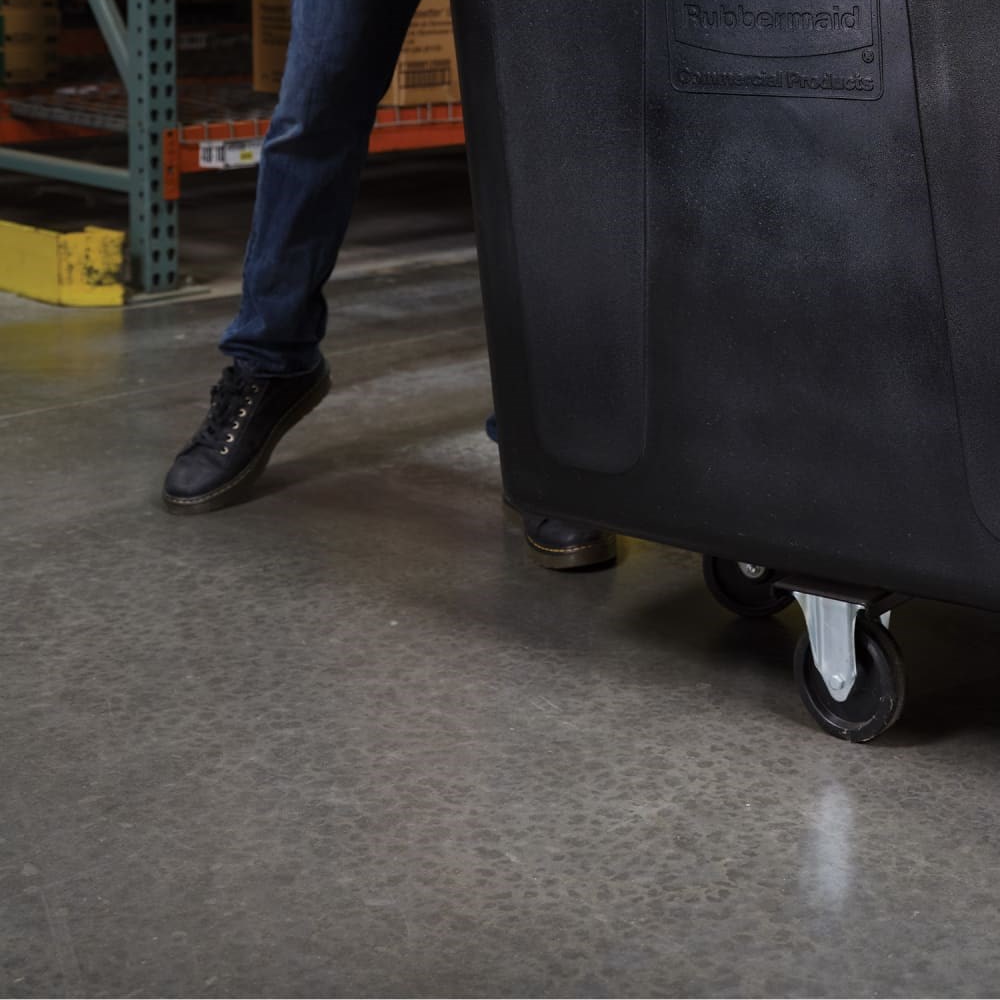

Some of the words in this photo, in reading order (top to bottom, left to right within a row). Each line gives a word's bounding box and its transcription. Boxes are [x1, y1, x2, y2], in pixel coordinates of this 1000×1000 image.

[683, 3, 860, 32] Rubbermaid
[676, 69, 783, 89] Commercial
[785, 71, 875, 92] Products
